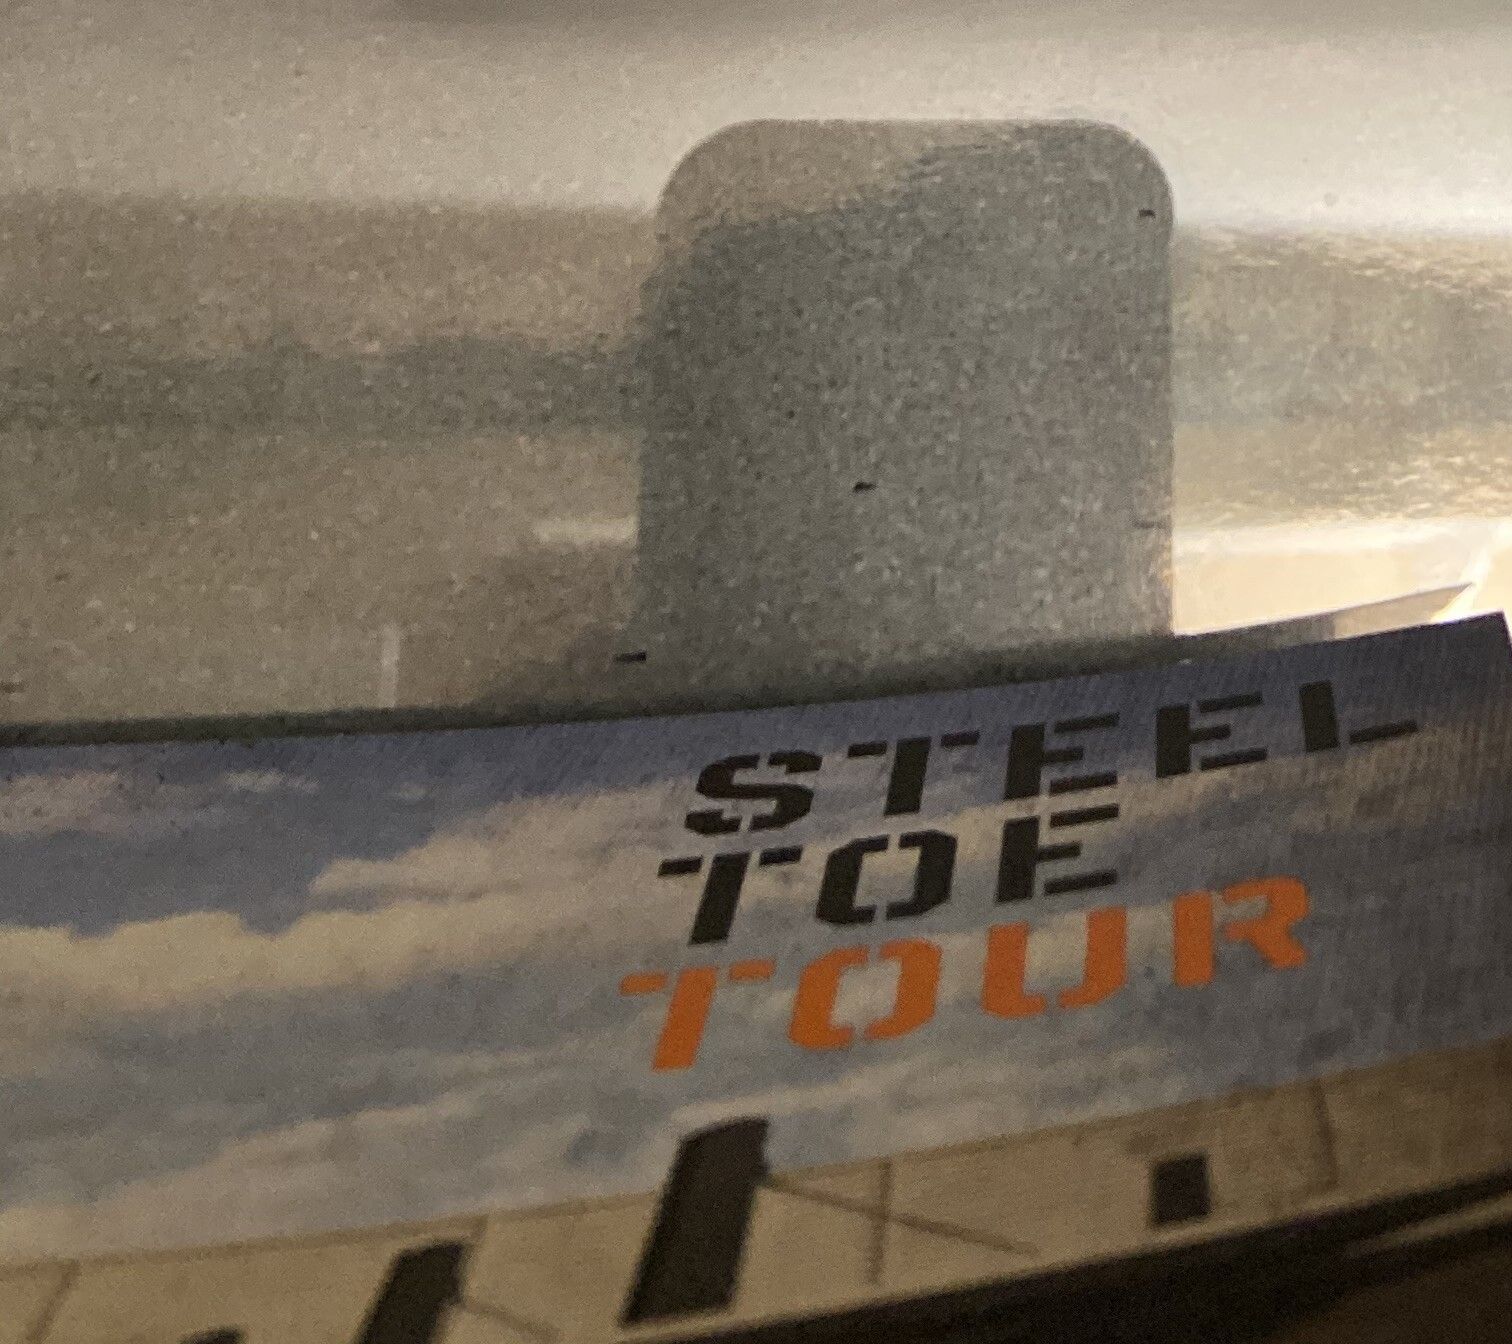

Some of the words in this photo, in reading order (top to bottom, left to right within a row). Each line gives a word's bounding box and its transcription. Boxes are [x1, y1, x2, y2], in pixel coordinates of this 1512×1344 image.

[684, 680, 1419, 835] STEEL
[657, 803, 1120, 946] TOE
[619, 875, 1309, 1073] TOUR
